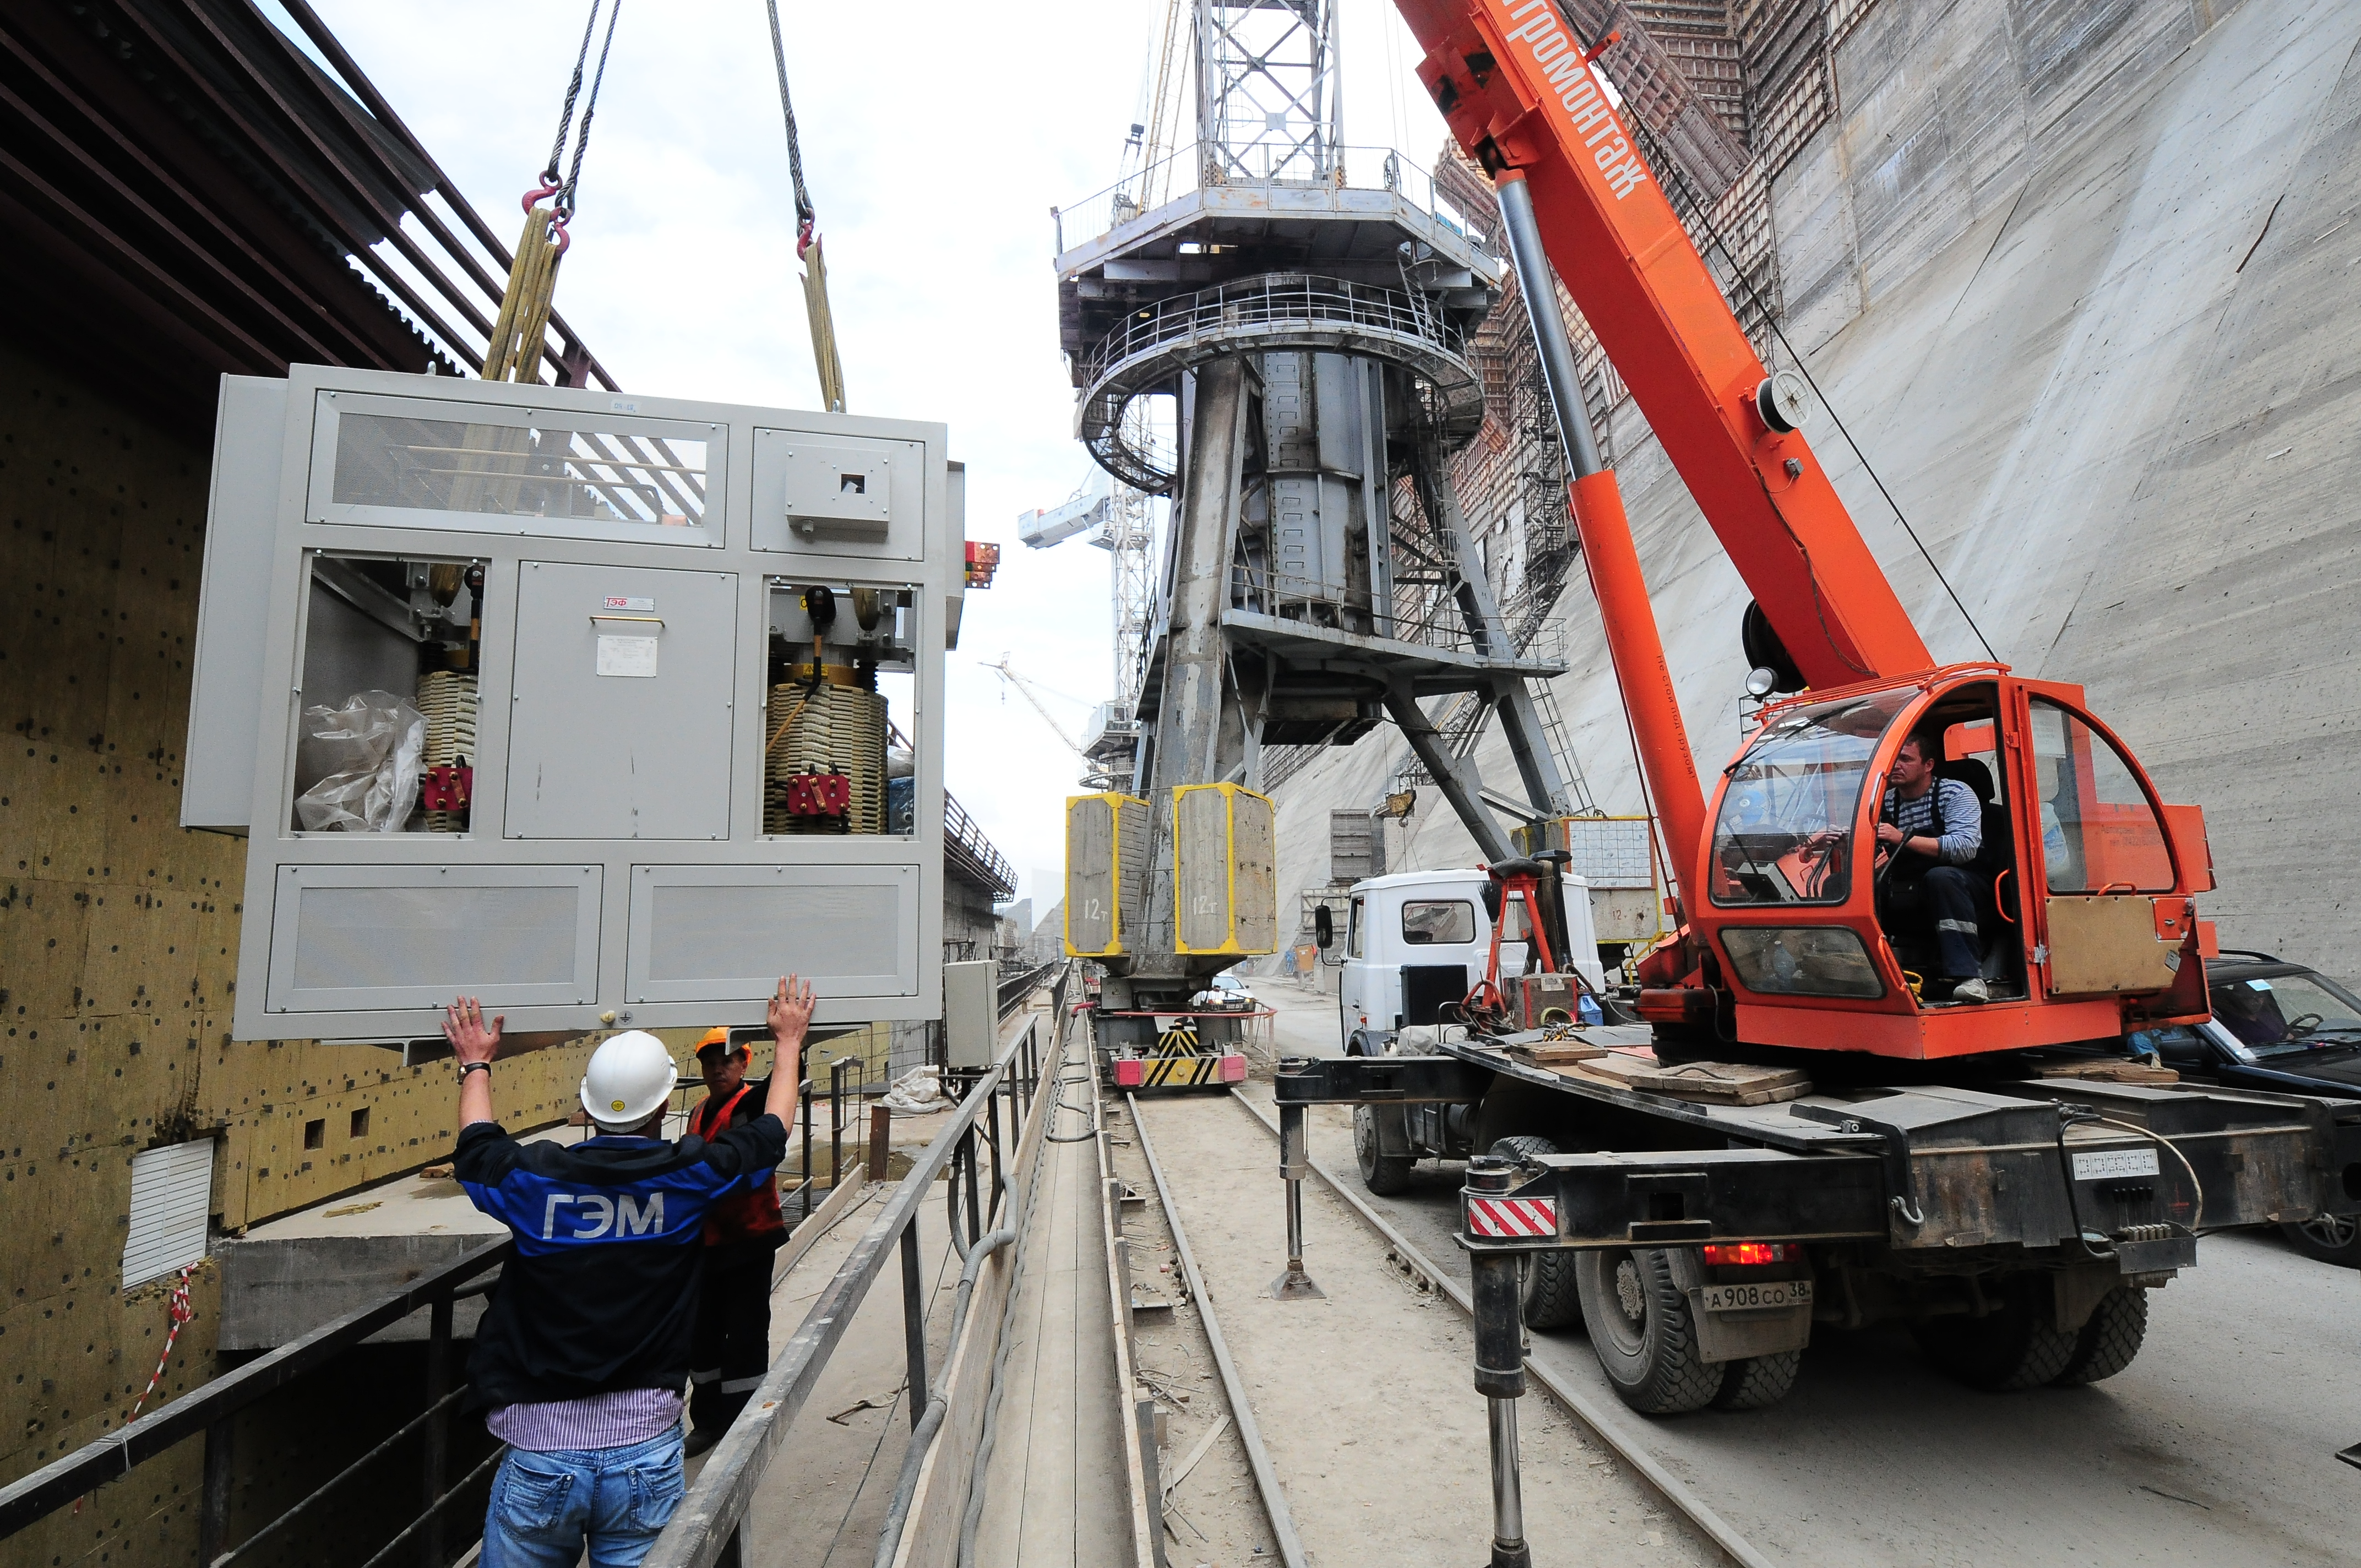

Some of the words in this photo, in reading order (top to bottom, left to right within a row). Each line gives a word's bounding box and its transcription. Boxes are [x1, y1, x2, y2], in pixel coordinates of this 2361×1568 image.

[1503, 0, 1647, 200] тромонтаж
[606, 597, 628, 607] ТЭФ
[1656, 655, 1664, 671] Не
[542, 1192, 664, 1239] ГЭМ
